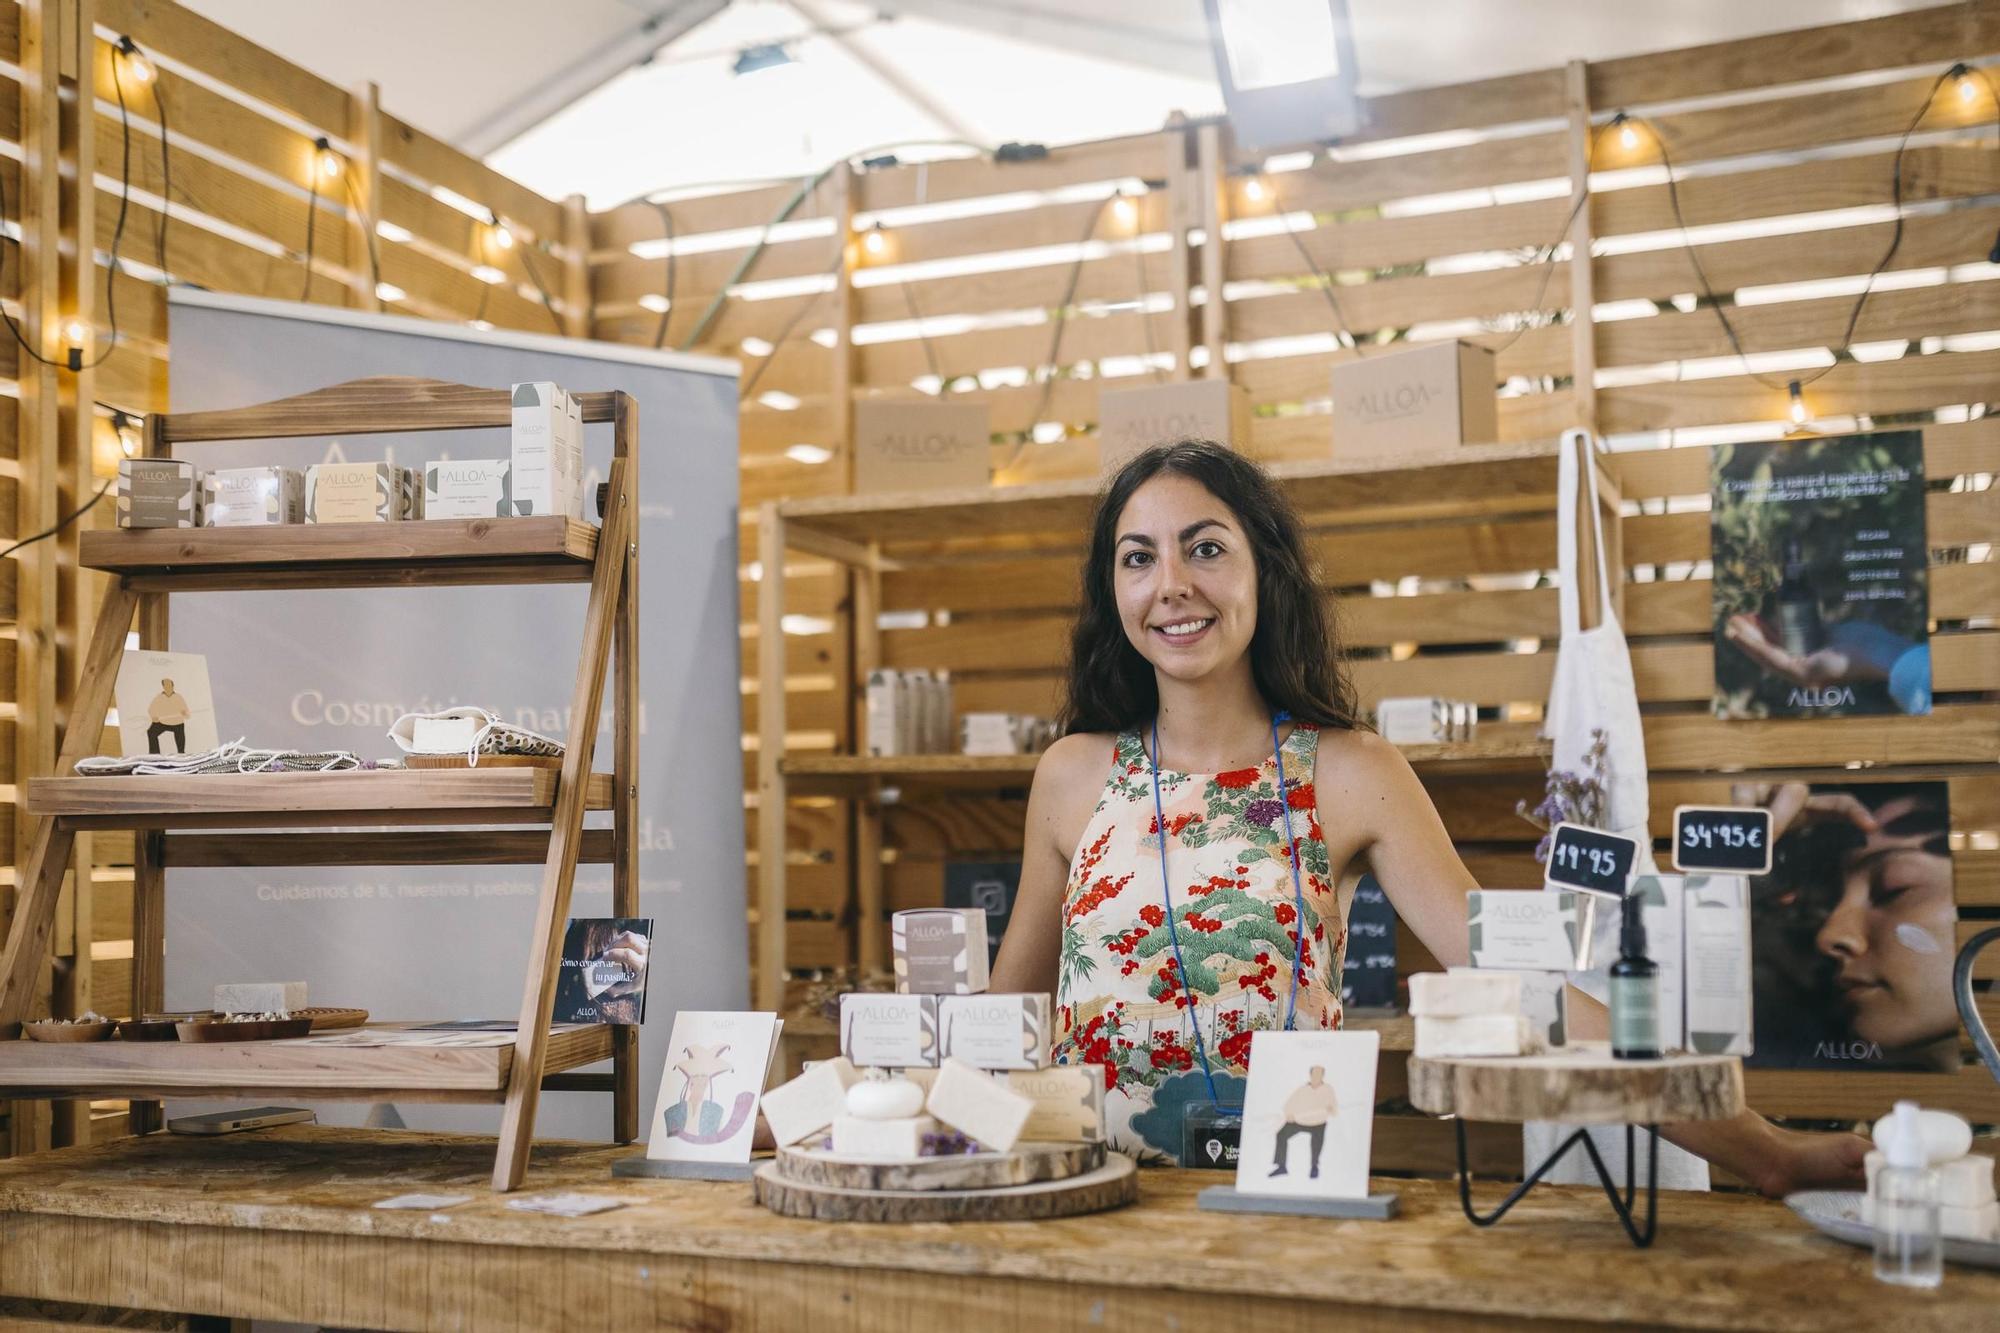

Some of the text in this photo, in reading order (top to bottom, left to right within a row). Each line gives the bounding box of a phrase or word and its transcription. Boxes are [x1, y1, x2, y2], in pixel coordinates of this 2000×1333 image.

[1357, 382, 1431, 418] ALLOA
[136, 471, 172, 481] ALLOA
[325, 471, 368, 485] ALLOA
[445, 470, 488, 482] ALLOA
[1788, 687, 1855, 707] ALLOA
[1556, 842, 1617, 877] 19'95
[256, 882, 348, 901] Cuidamos
[352, 883, 375, 899] de
[911, 925, 946, 938] ALLOA
[577, 1007, 597, 1016] ALLOA
[860, 1006, 911, 1019] ALLOA
[961, 1007, 1011, 1020] ALLOA
[1814, 1041, 1884, 1060] ALLOA
